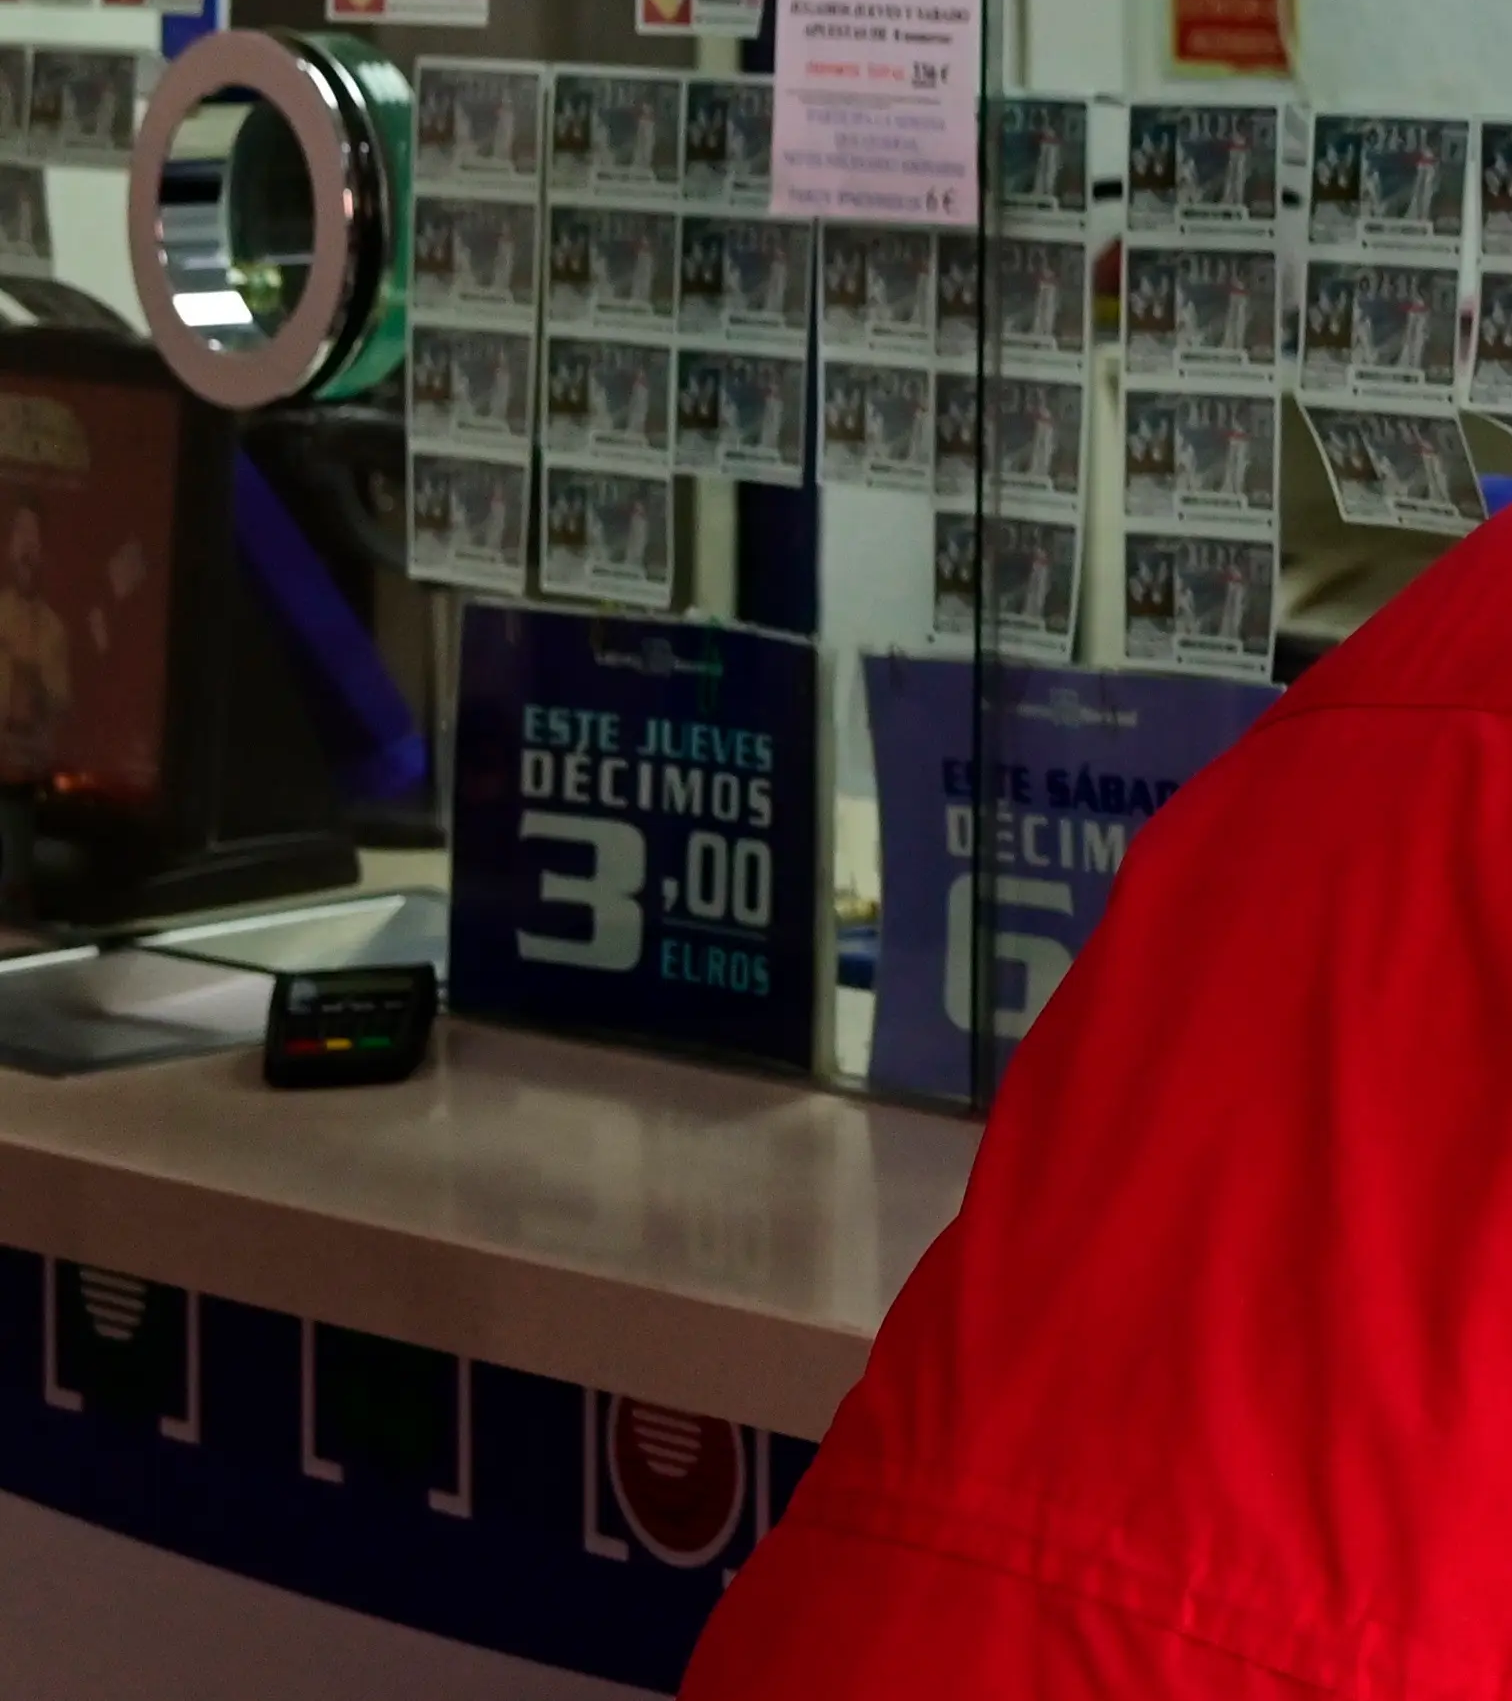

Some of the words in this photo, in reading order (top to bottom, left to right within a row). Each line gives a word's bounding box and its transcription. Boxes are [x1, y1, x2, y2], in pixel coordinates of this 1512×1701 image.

[524, 703, 620, 751] ESTE
[638, 719, 772, 772] JUEVES
[520, 745, 772, 828] DÉCIMOS
[516, 809, 772, 973] 3,00
